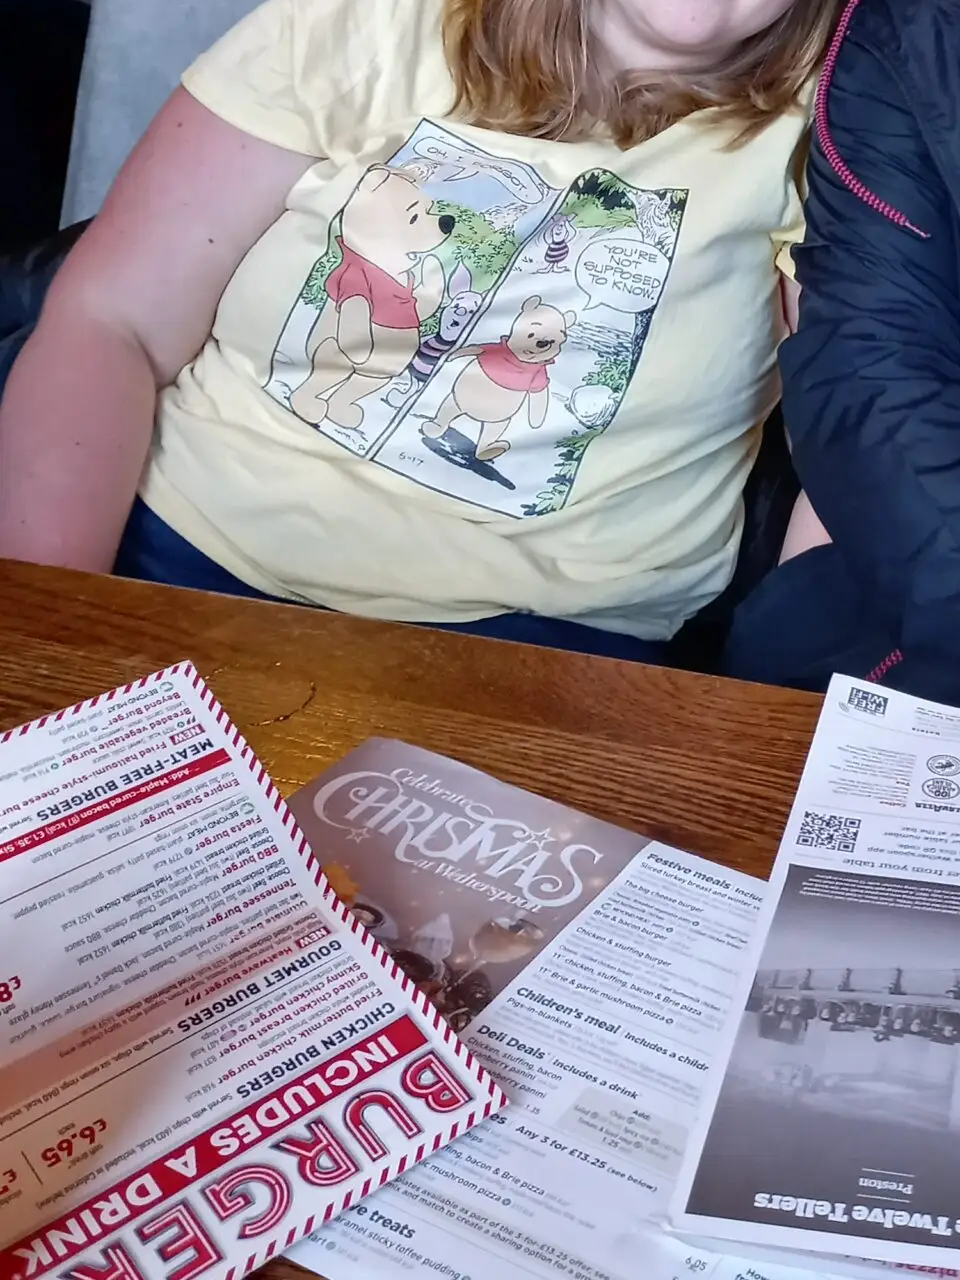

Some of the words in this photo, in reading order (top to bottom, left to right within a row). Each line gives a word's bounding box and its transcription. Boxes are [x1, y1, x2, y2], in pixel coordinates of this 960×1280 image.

[603, 244, 657, 264] YOU'RE
[609, 255, 641, 269] NOT
[584, 262, 661, 290] SUPPOSED
[589, 273, 608, 286] TO
[612, 277, 655, 300] KNOW.
[140, 690, 181, 712] Beyond
[846, 696, 883, 714] FREE
[849, 687, 886, 705] Wi-Fi
[147, 706, 192, 729] Breaded
[95, 723, 149, 751] vegetable
[170, 725, 201, 743] NEW
[58, 744, 98, 767] burger
[117, 737, 214, 786] MEAT-FREE
[137, 740, 167, 758] Fried
[59, 752, 139, 792] halloumi-style
[166, 767, 191, 782] Add:
[20, 785, 61, 808] cheese
[34, 778, 118, 822] BURGERS
[106, 775, 168, 808] Maple-cured
[200, 776, 240, 799] Empire
[391, 767, 493, 816] Celebrate
[79, 802, 110, 820] bacon
[135, 805, 175, 829] burger
[174, 794, 203, 812] State
[228, 813, 263, 835] Fiesta
[191, 828, 231, 852] burger
[255, 843, 278, 859] BBQ
[219, 853, 256, 877] burger
[646, 853, 692, 874] Festive
[693, 869, 731, 889] meals
[840, 857, 876, 869] table
[877, 859, 910, 872] your
[910, 866, 943, 877] from
[241, 876, 296, 910] Tennessee
[414, 858, 433, 870] at
[434, 863, 544, 913] Wetherspoon
[623, 880, 639, 889] The
[637, 886, 650, 894] big
[650, 889, 678, 903] cheese
[677, 900, 704, 913] burger
[639, 862, 662, 874] Sliced
[661, 870, 687, 883] turkey
[686, 879, 712, 893] breast
[711, 889, 727, 898] and
[726, 895, 752, 908] winter
[203, 903, 243, 929] burger
[593, 908, 611, 919] Brie
[617, 918, 641, 930] bacon
[640, 927, 668, 941] burger
[298, 926, 326, 946] NEW
[575, 926, 607, 942] Chicken
[612, 940, 645, 958] stuffing
[643, 953, 671, 968] burger
[239, 945, 292, 977] Heatwave
[261, 937, 342, 988] GOURMET
[324, 960, 361, 986] Skinny
[202, 971, 241, 997] burger
[285, 979, 327, 1007] chicken
[330, 969, 369, 996] Grilled
[562, 956, 596, 974] chicken,
[595, 969, 630, 988] stuffing,
[629, 982, 654, 997] bacon
[661, 995, 680, 1008] Brie
[679, 1003, 702, 1017] pizza
[175, 981, 260, 1034] BURGERS
[290, 989, 333, 1019] chicken
[352, 986, 383, 1008] Fried
[550, 971, 570, 983] Brie
[568, 978, 577, 986] &
[574, 981, 600, 996] garlic
[599, 990, 644, 1013] mushroom
[642, 1008, 665, 1023] pizza
[246, 1000, 288, 1028] burger
[254, 1012, 293, 1038] breast
[296, 1002, 354, 1040] buttermilk
[320, 1000, 396, 1050] CHICKEN
[507, 996, 572, 1029] Pigs-in-blankets
[515, 986, 584, 1021] Children's
[584, 1012, 621, 1034] meal
[624, 1031, 668, 1056] Includes
[216, 1030, 257, 1060] burger
[254, 1034, 298, 1063] chicken
[214, 1056, 256, 1085] burger
[235, 1043, 320, 1099] BURGERS
[476, 1023, 508, 1043] Deli
[551, 1058, 599, 1084] Includes
[609, 1082, 639, 1100] drink
[210, 1035, 398, 1160] INCLUDES
[37, 1114, 113, 1170] £6.65
[165, 1146, 197, 1183] A
[513, 1123, 540, 1142] Any
[548, 1138, 569, 1154] for
[567, 1146, 608, 1171] £13.25
[606, 1164, 627, 1179] (see
[625, 1173, 659, 1194] below)
[857, 1175, 914, 1195] Preston
[751, 1190, 850, 1222] Tellers
[851, 1203, 953, 1236] Twelve
[366, 1207, 421, 1240] treats
